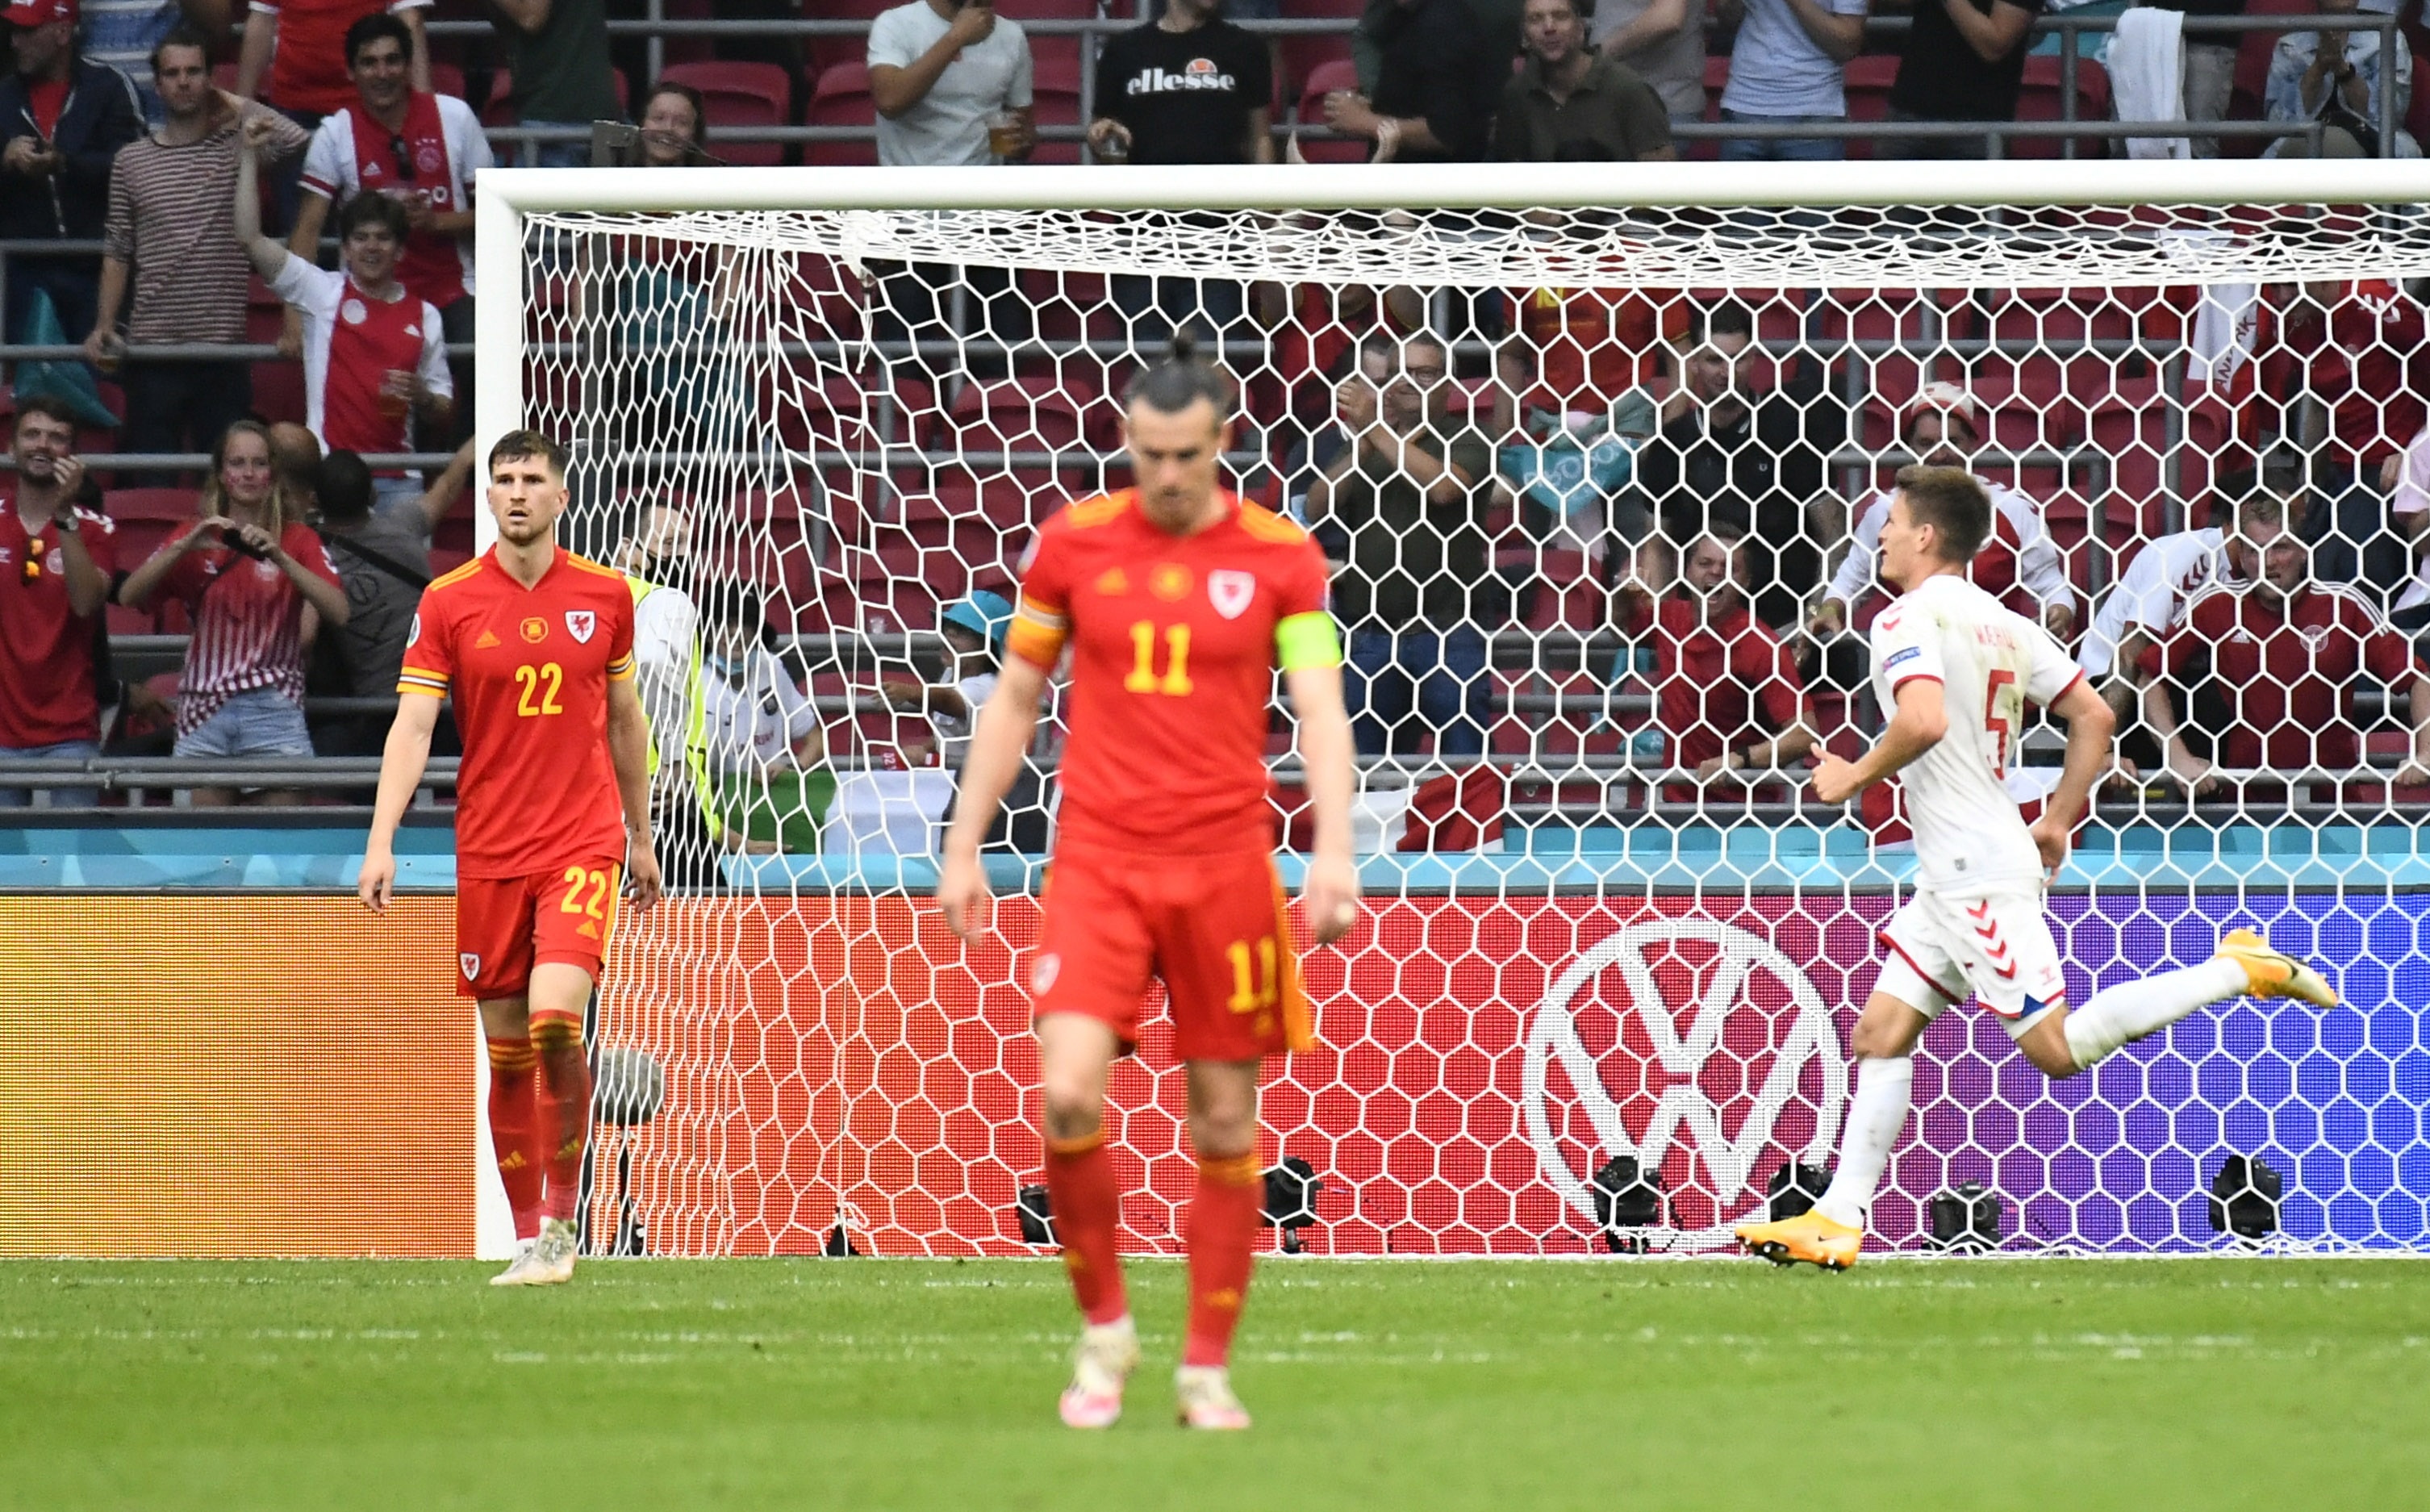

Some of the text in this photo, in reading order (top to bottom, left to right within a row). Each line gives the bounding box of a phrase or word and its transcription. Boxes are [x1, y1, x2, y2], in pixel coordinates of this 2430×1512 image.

[1127, 67, 1235, 95] ellesse
[515, 662, 563, 717] 22
[1123, 620, 1194, 697] 11
[1985, 668, 2016, 781] 5
[561, 865, 606, 921] 22
[1225, 938, 1276, 1013] 11
[1537, 922, 1830, 1218] VW
